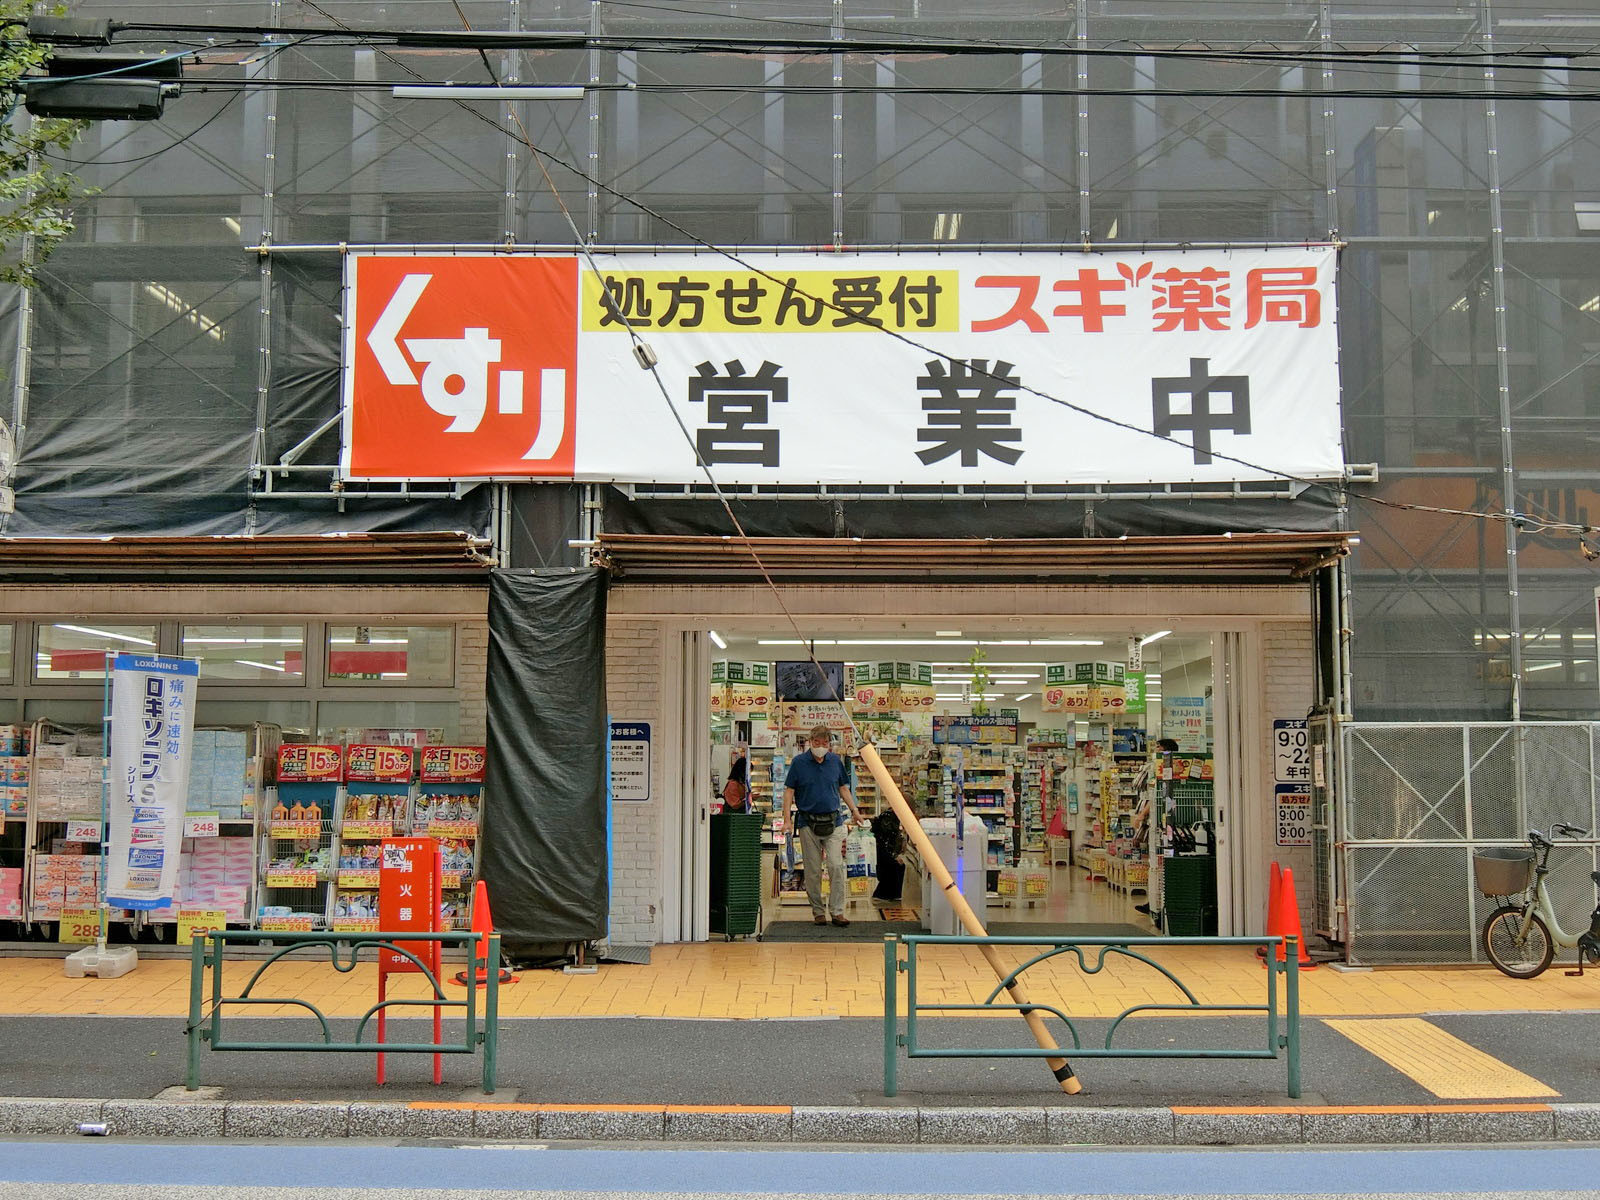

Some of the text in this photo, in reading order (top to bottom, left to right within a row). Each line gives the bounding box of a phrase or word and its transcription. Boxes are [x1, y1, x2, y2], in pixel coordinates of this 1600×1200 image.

[599, 274, 943, 328] 処方せん受付
[971, 263, 1320, 332] スギ薬局
[366, 272, 566, 463] くすり
[689, 357, 1251, 470] 営業中
[746, 667, 751, 677] 3
[166, 679, 184, 760] 痛みに速効。
[127, 766, 137, 803] シリーズ
[75, 828, 96, 837] 248
[193, 823, 214, 831] 248
[391, 954, 418, 964] 中野
